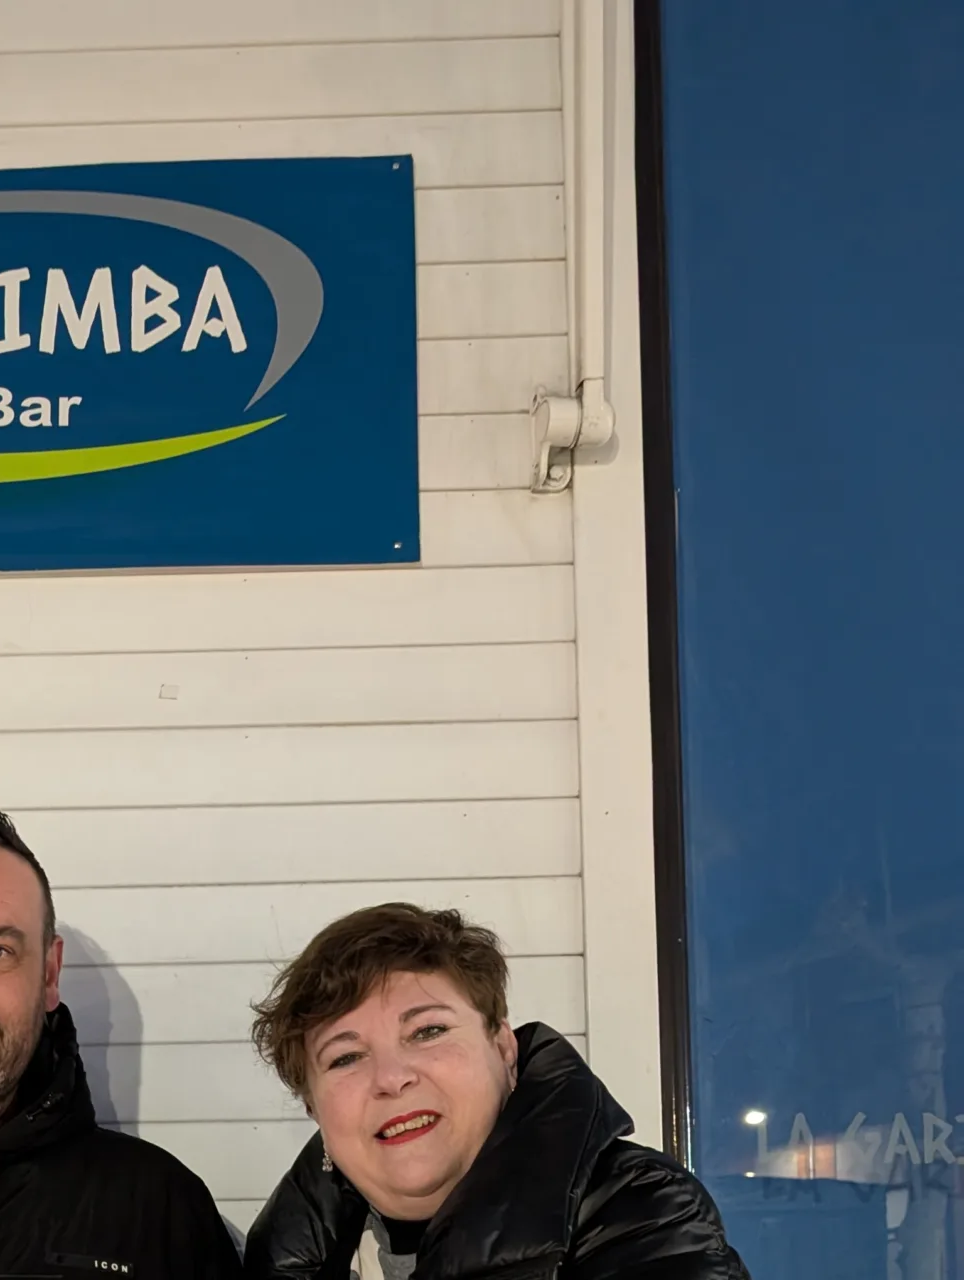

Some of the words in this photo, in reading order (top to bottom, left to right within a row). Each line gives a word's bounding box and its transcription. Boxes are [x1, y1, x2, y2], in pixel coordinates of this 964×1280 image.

[756, 1112, 817, 1165] LA
[838, 1111, 964, 1165] GAR
[94, 1260, 129, 1273] ICON
